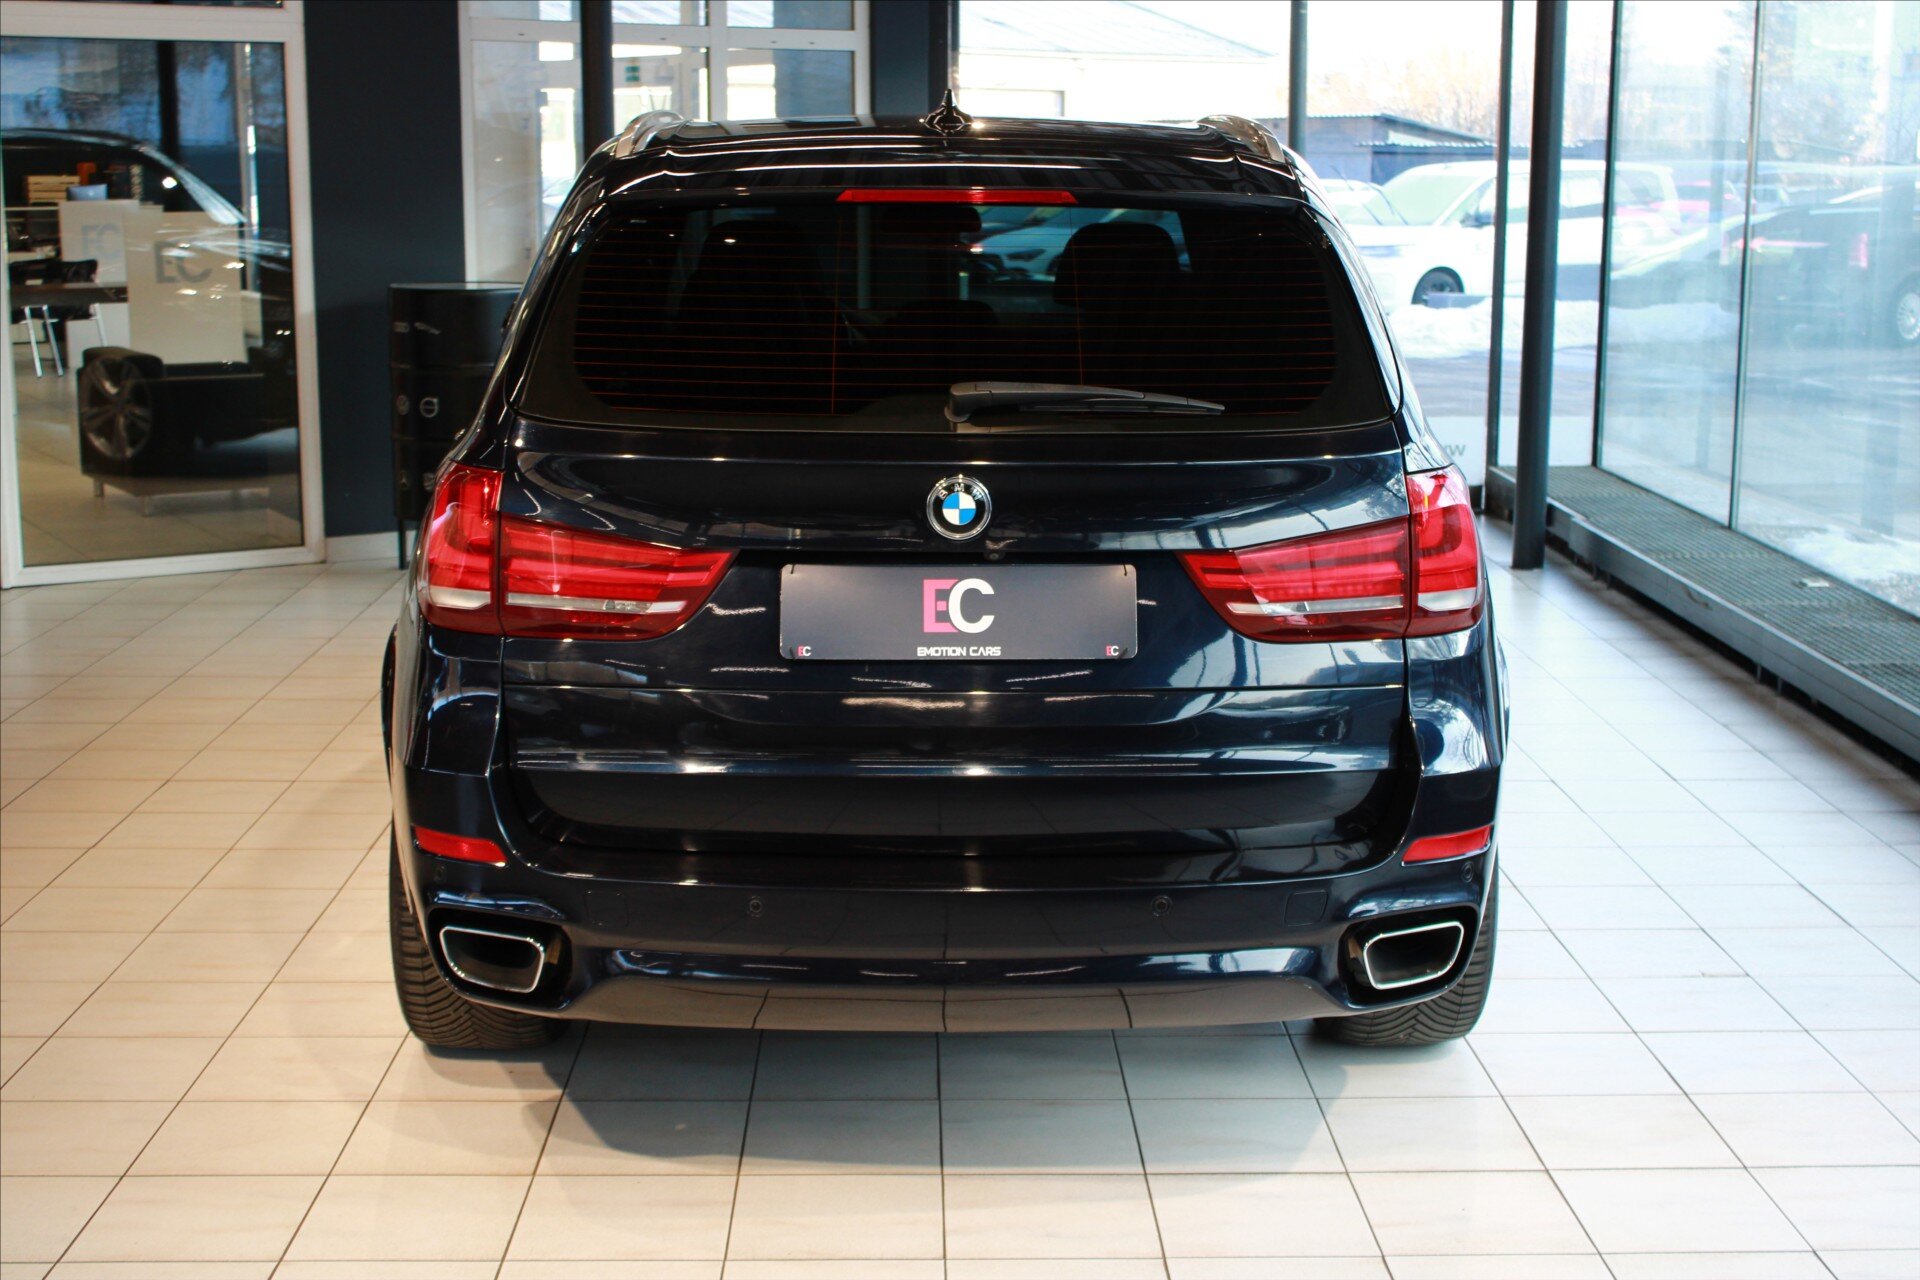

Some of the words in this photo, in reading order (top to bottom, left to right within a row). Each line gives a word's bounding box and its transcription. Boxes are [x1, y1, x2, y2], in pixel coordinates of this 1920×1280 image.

[938, 482, 984, 500] BMW
[923, 578, 995, 633] EC
[798, 646, 811, 657] EC
[917, 646, 967, 657] EMOTION
[969, 646, 1002, 657] CARS
[1106, 645, 1119, 656] EC
